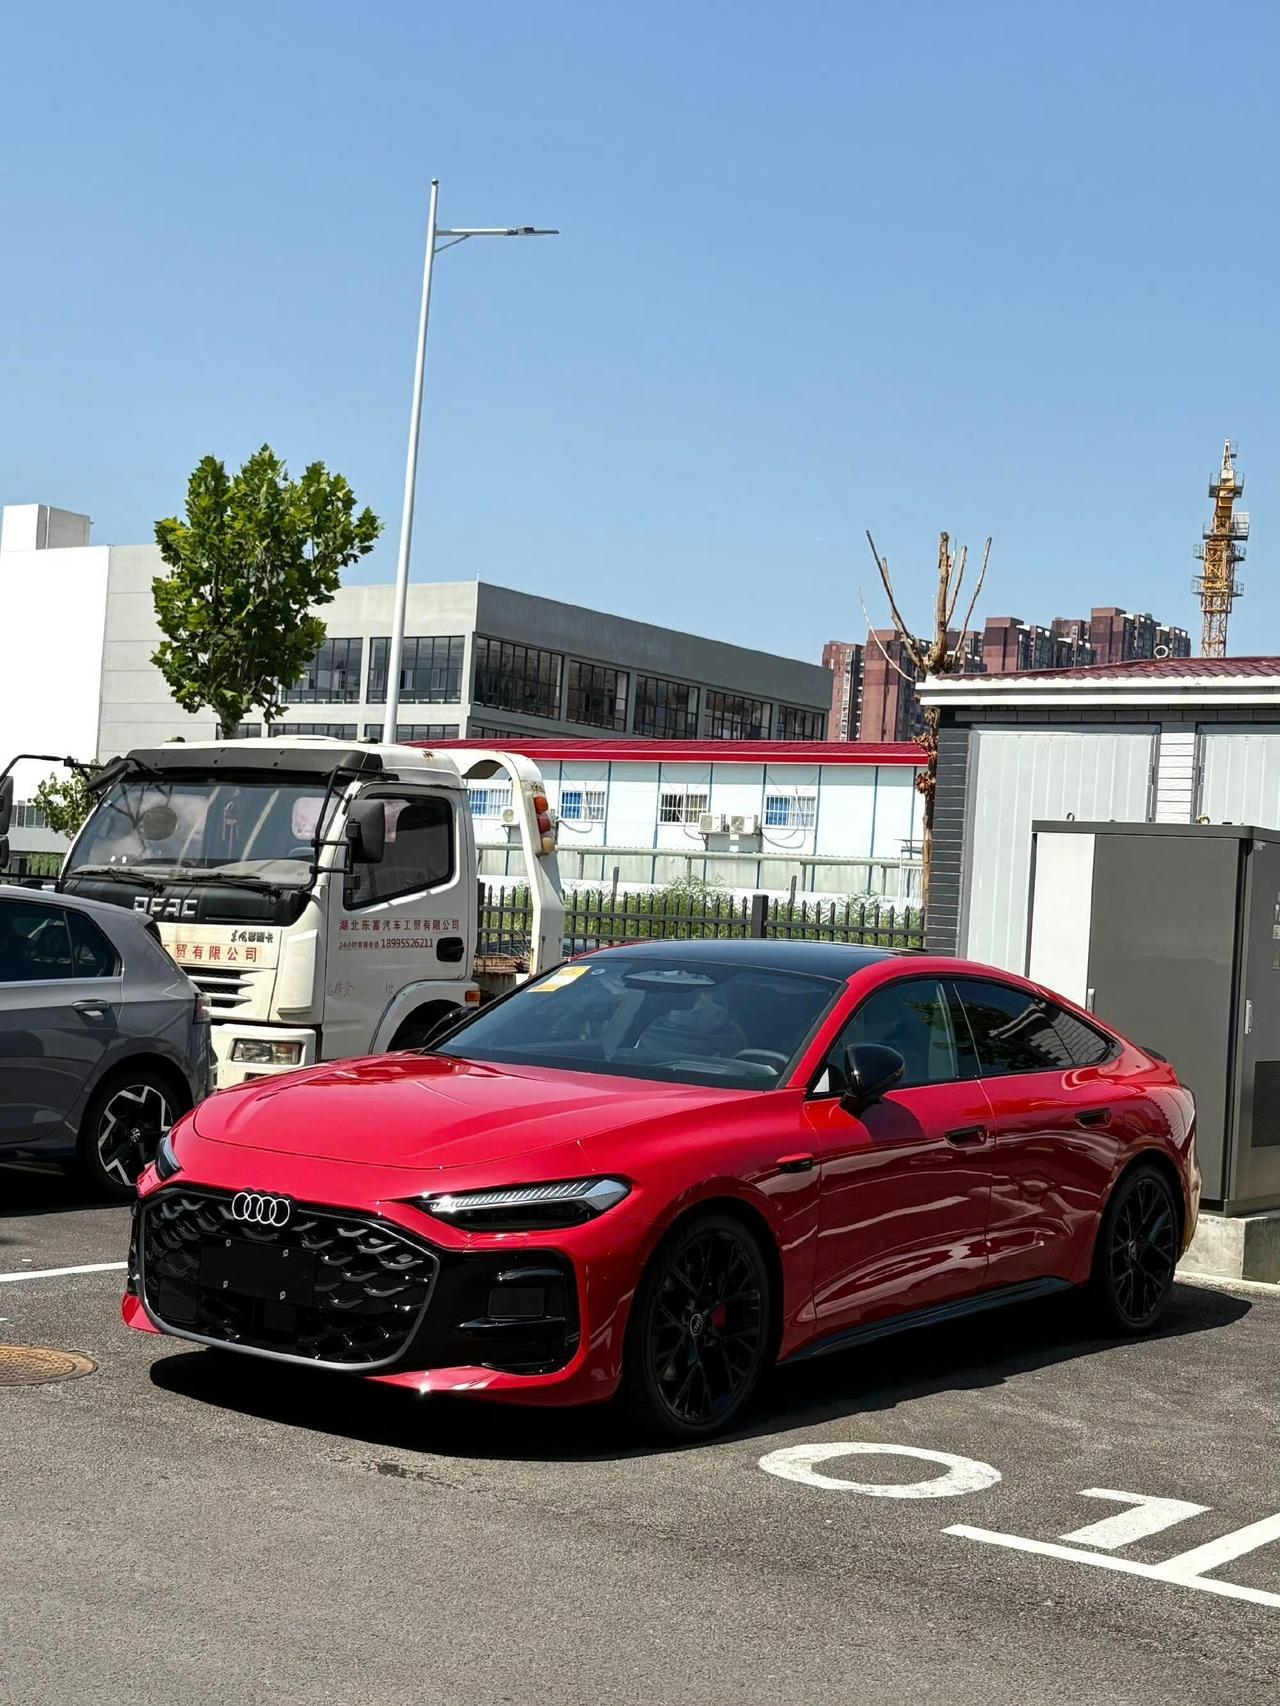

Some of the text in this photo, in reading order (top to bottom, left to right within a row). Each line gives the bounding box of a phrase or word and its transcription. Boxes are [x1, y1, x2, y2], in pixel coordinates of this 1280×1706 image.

[133, 896, 198, 918] DFAC
[339, 919, 460, 932] 湖北东富汽车工贸有限公司
[381, 937, 434, 949] 18995526211
[162, 944, 258, 963] 贸有限公司
